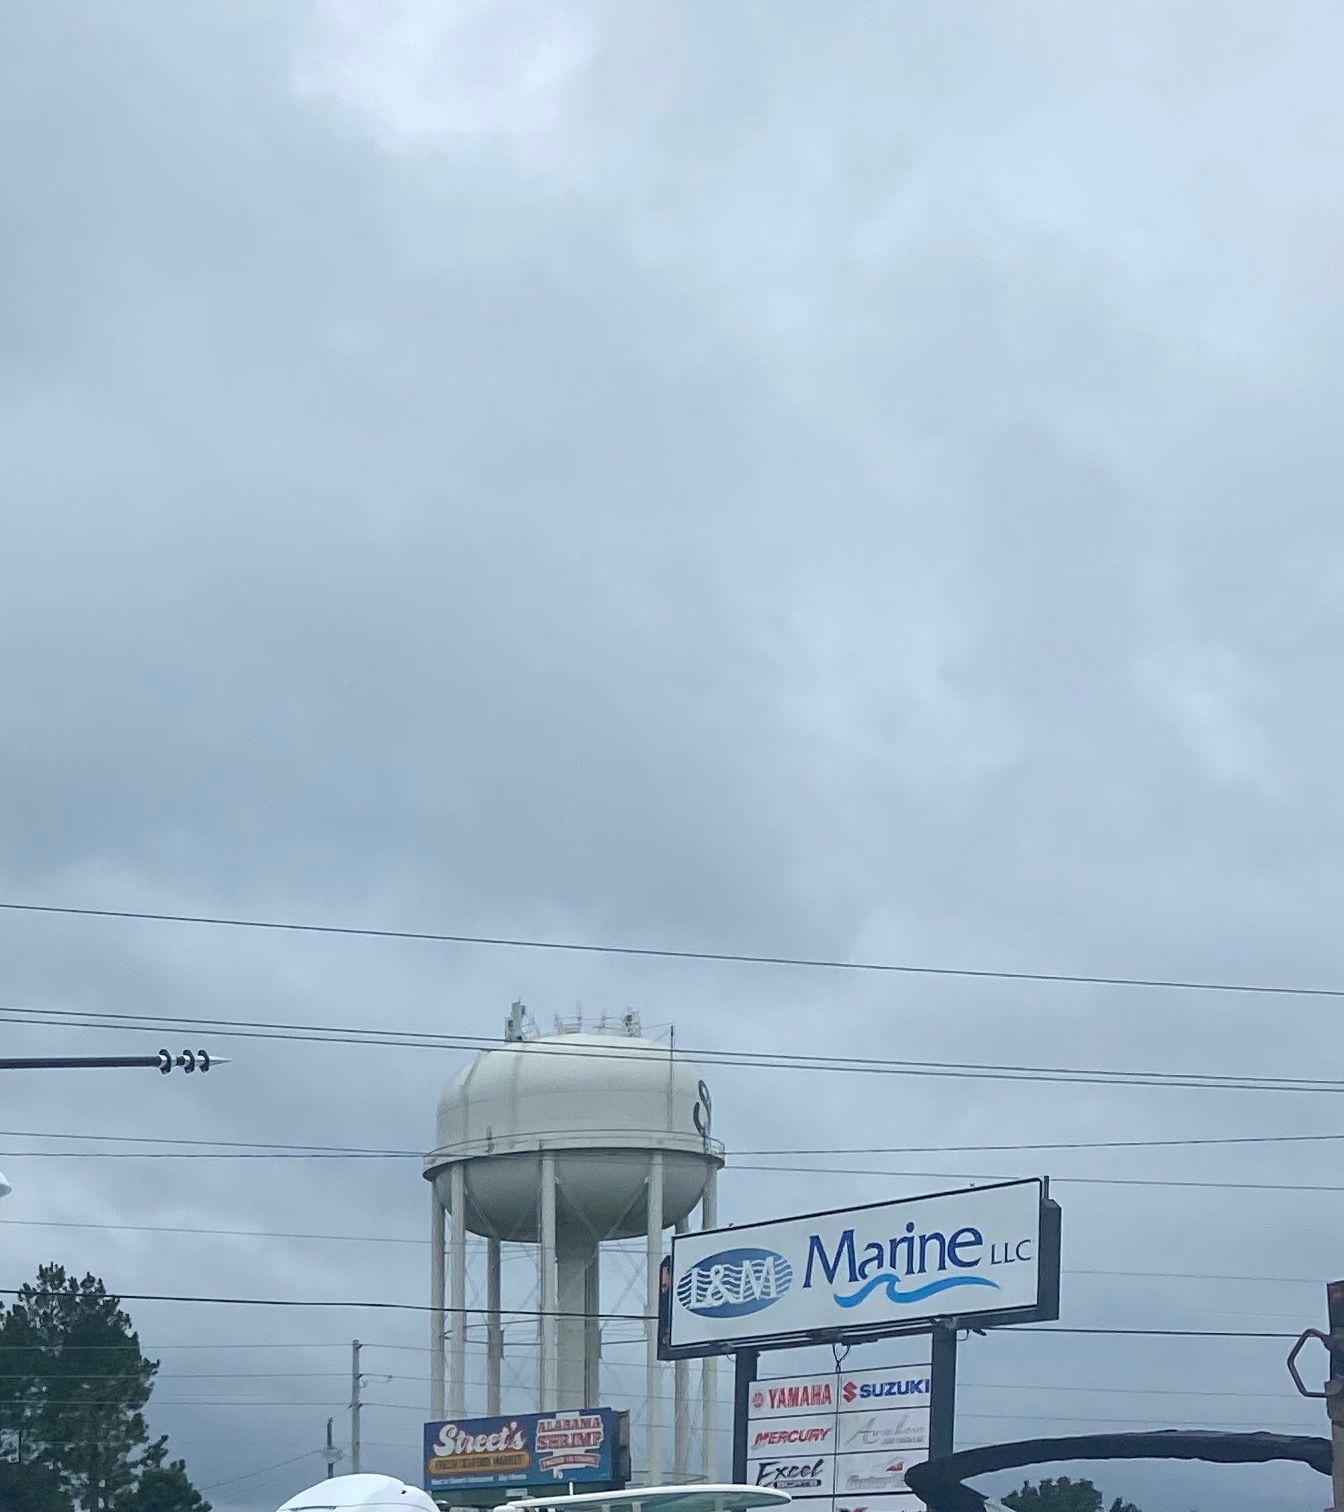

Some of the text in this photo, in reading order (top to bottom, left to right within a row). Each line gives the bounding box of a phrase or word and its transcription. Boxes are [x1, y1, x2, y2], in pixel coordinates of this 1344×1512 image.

[687, 1222, 1032, 1309] L&M Marine LLC
[768, 1383, 833, 1410] YAMAHA
[859, 1379, 931, 1399] SUZUKI
[433, 1422, 527, 1457] Street's
[753, 1428, 833, 1447] MERCURY
[756, 1459, 824, 1487] Excel
